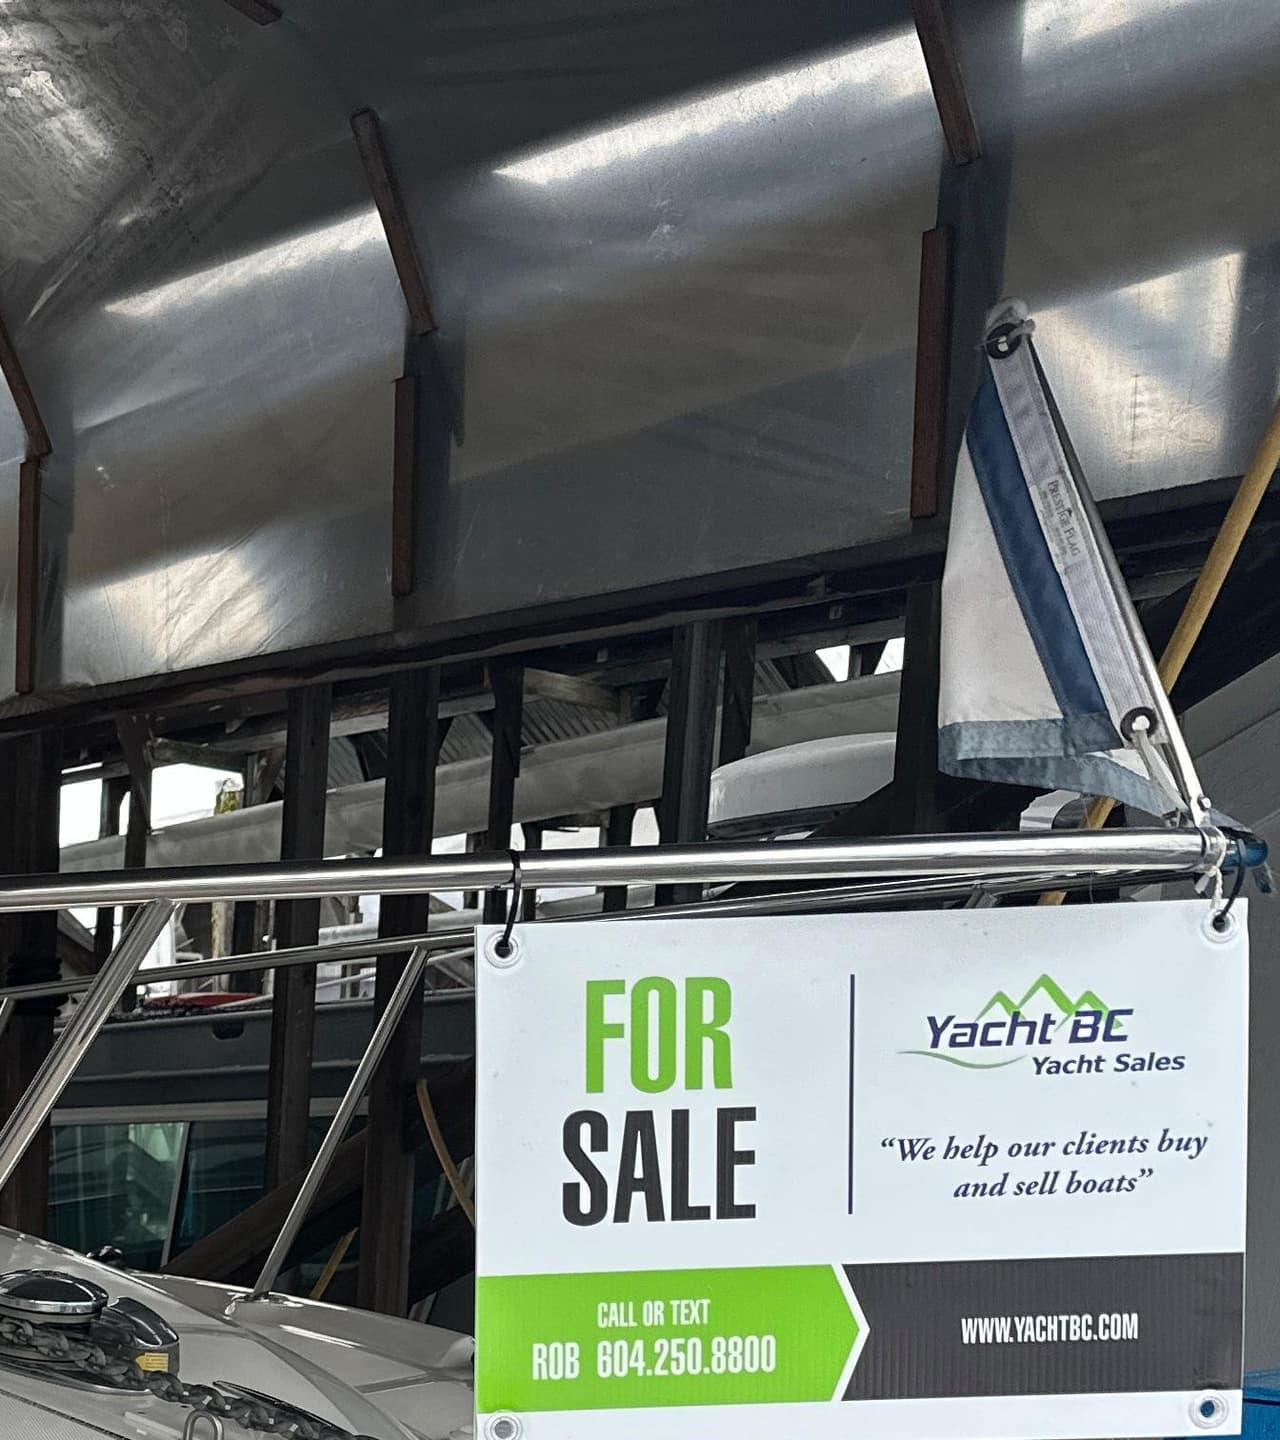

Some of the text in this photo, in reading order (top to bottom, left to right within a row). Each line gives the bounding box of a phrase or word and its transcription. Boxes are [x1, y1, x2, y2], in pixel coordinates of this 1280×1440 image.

[586, 976, 732, 1093] FOR
[926, 1008, 1134, 1048] Yacht BC
[1032, 1051, 1186, 1076] Yacht Sales
[562, 1106, 757, 1227] SALE
[880, 1126, 1209, 1167] “We help our clients buy
[953, 1167, 1154, 1198] and sell boats”
[597, 1298, 710, 1328] CALL OR TEXT
[961, 1312, 1139, 1344] WWW.YACHTBC.COM
[532, 1333, 777, 1380] ROB 604.250.8800
